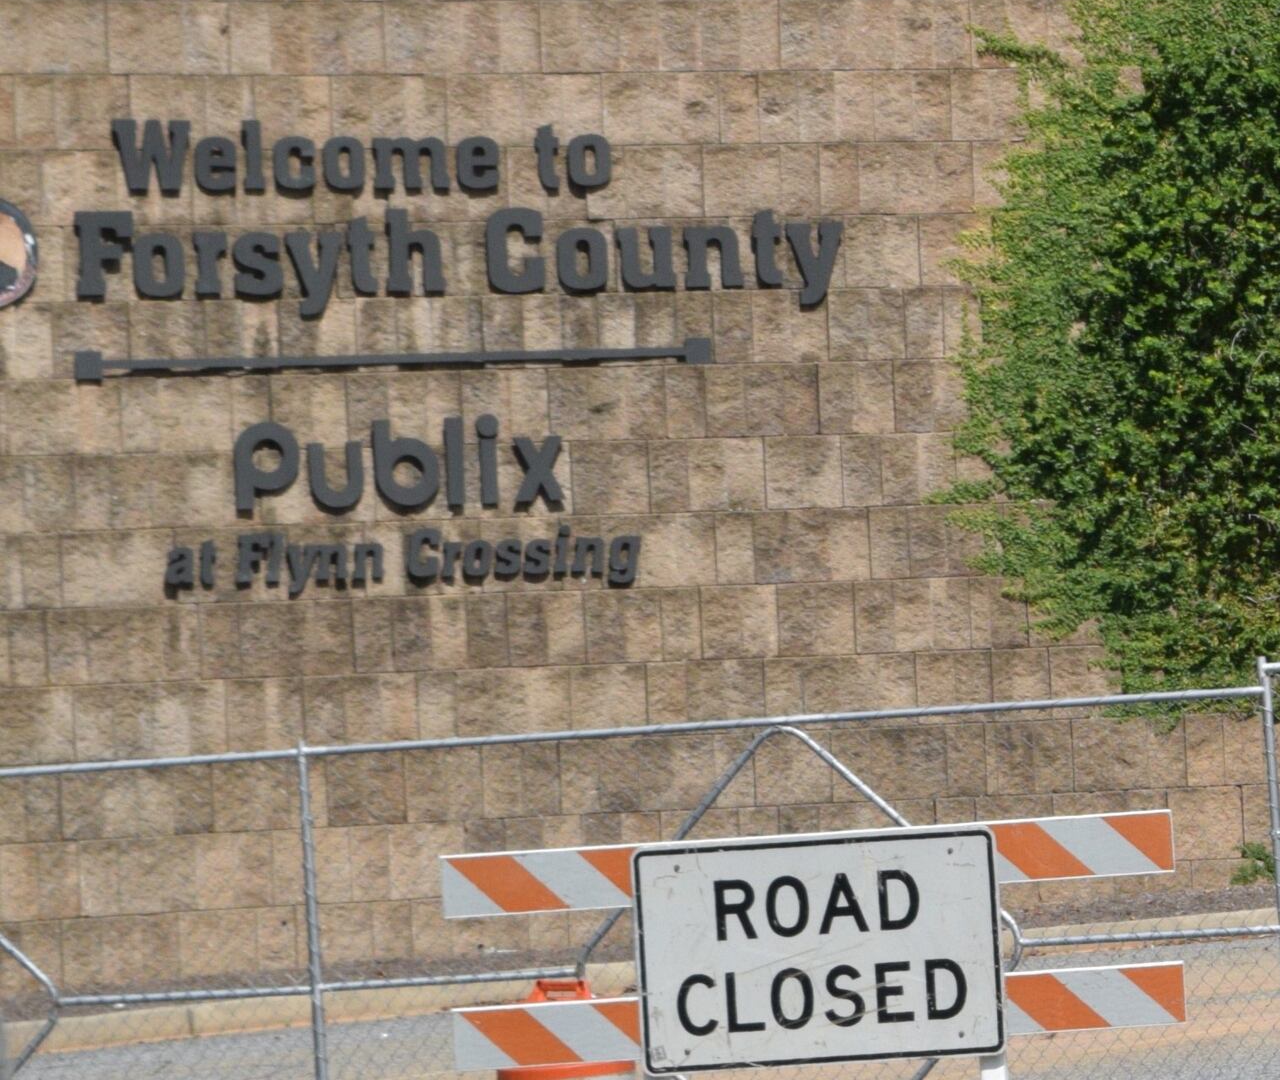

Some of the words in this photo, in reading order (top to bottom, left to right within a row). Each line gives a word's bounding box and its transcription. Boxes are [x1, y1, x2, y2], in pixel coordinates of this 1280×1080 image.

[111, 119, 501, 195] Welcome
[534, 124, 612, 191] to
[74, 208, 447, 317] Forsyth
[485, 207, 843, 308] County
[233, 413, 565, 514] Publix
[165, 535, 214, 595] at
[236, 532, 384, 595] Flynn
[405, 525, 641, 587] Crossing
[713, 869, 920, 941] ROAD
[676, 957, 967, 1037] CLOSED
